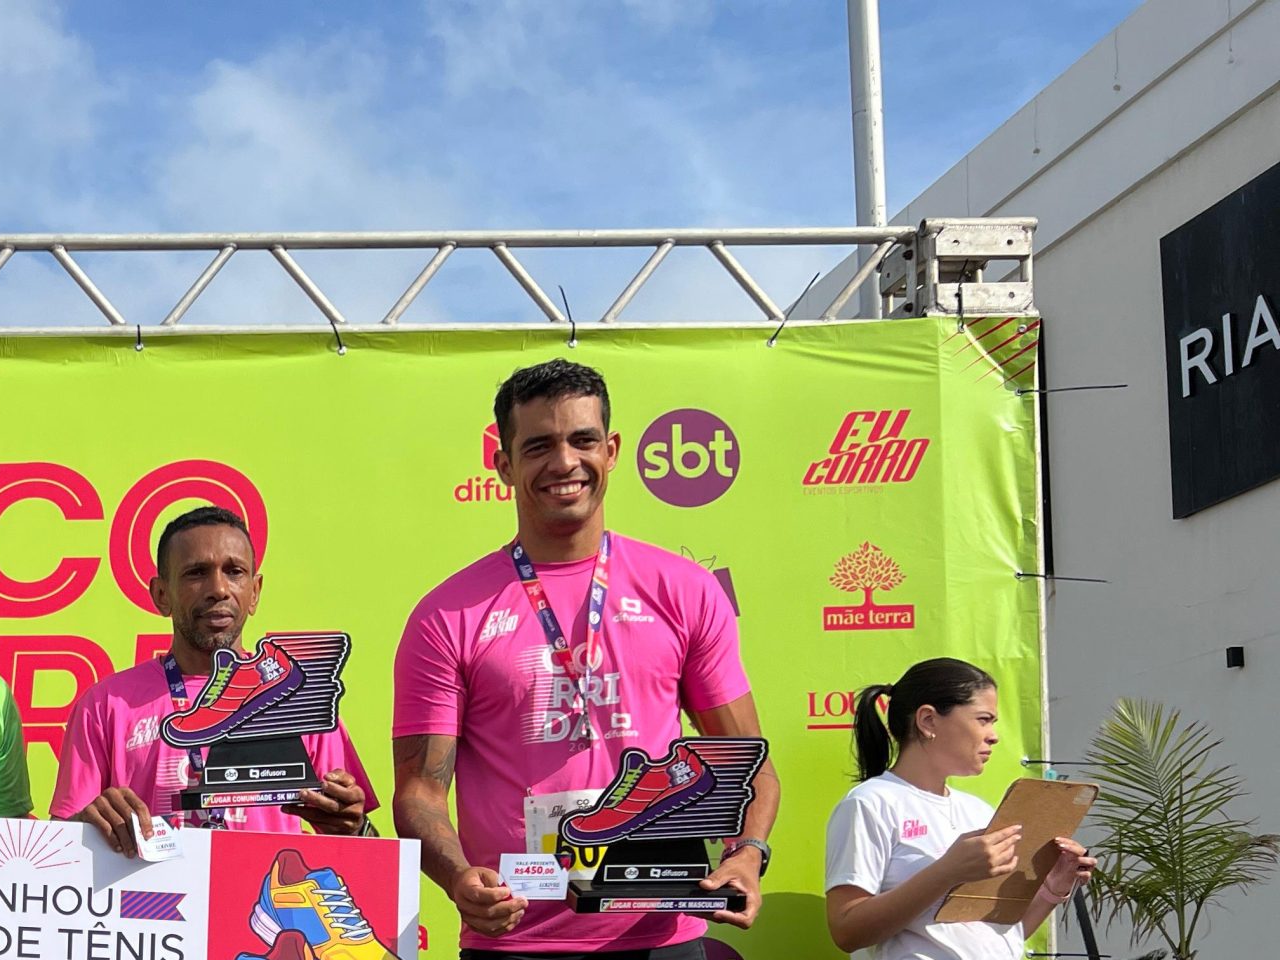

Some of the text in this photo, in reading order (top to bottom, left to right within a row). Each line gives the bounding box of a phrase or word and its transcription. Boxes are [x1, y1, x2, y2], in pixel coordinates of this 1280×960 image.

[643, 423, 733, 479] sbt
[828, 409, 912, 455] EU
[801, 438, 930, 485] CORRO
[454, 476, 512, 502] difu
[826, 608, 912, 626] mãe terra
